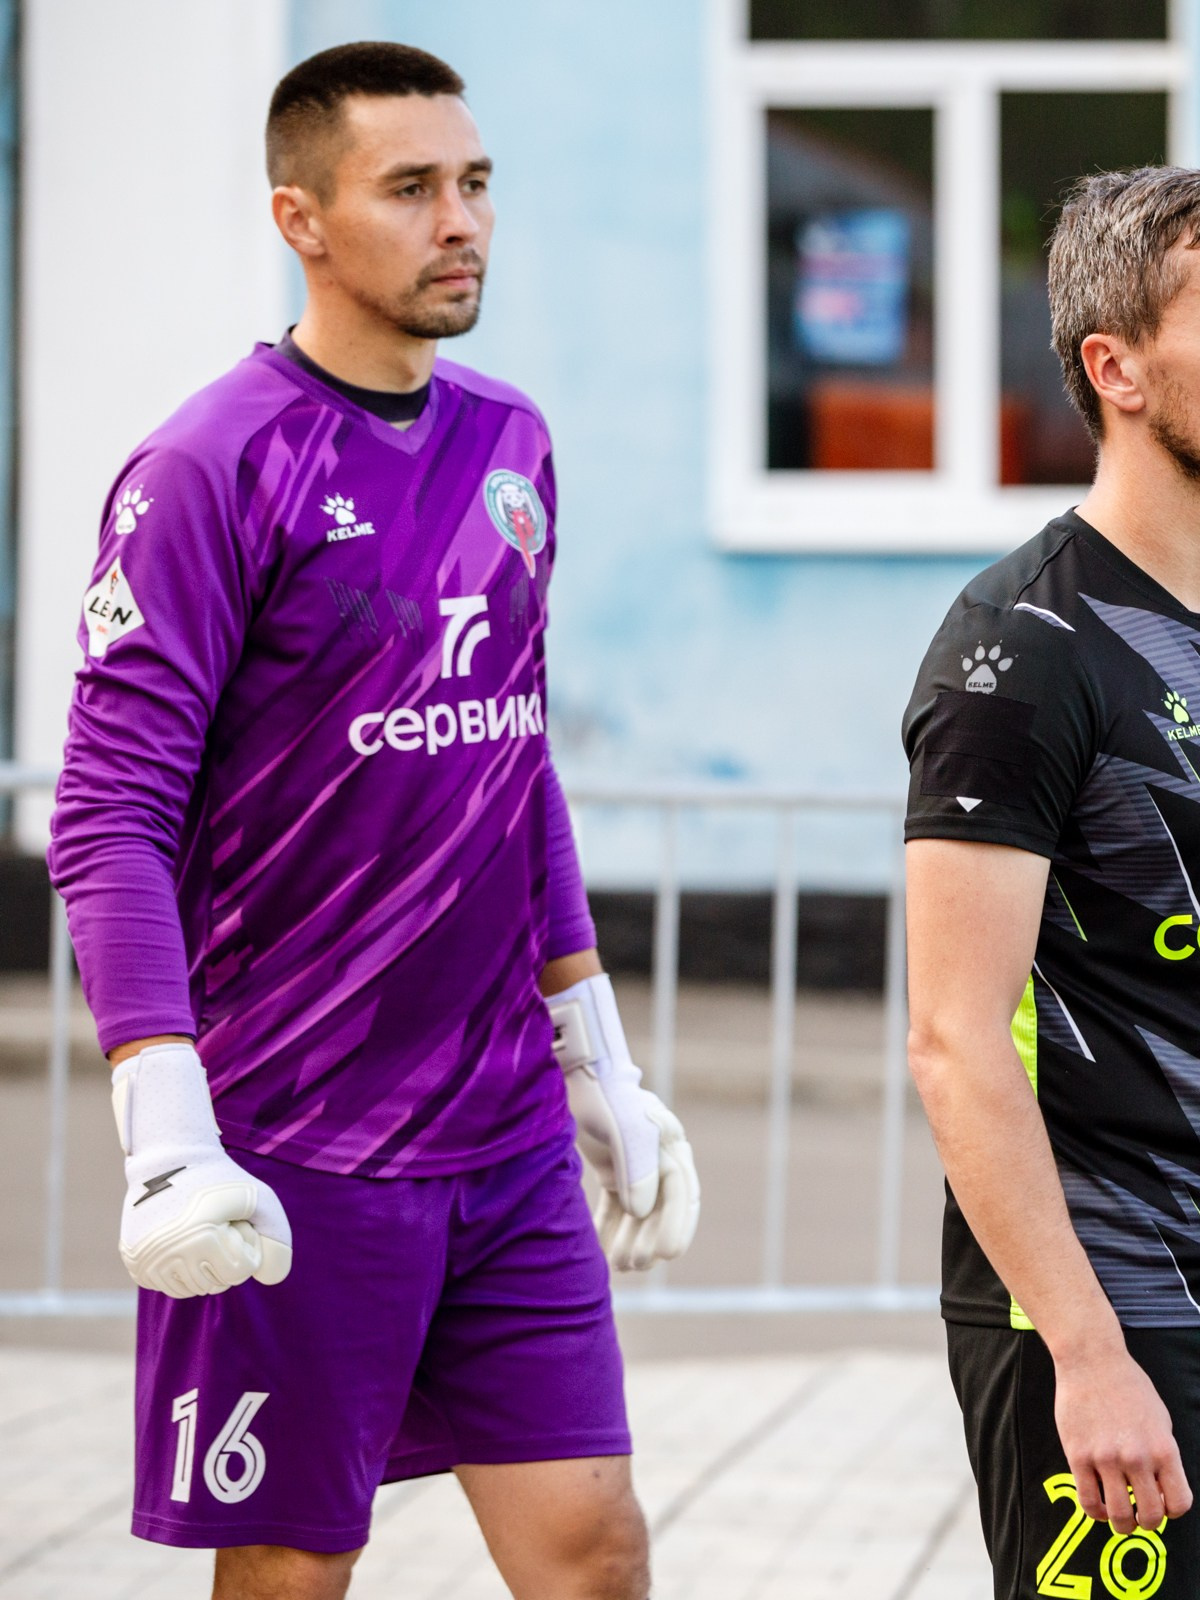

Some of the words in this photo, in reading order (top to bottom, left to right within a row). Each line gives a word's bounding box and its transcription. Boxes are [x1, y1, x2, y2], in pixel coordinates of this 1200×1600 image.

[326, 521, 376, 543] KELME
[967, 681, 995, 689] KELME
[170, 1387, 271, 1504] 16
[1036, 1472, 1168, 1600] 28
